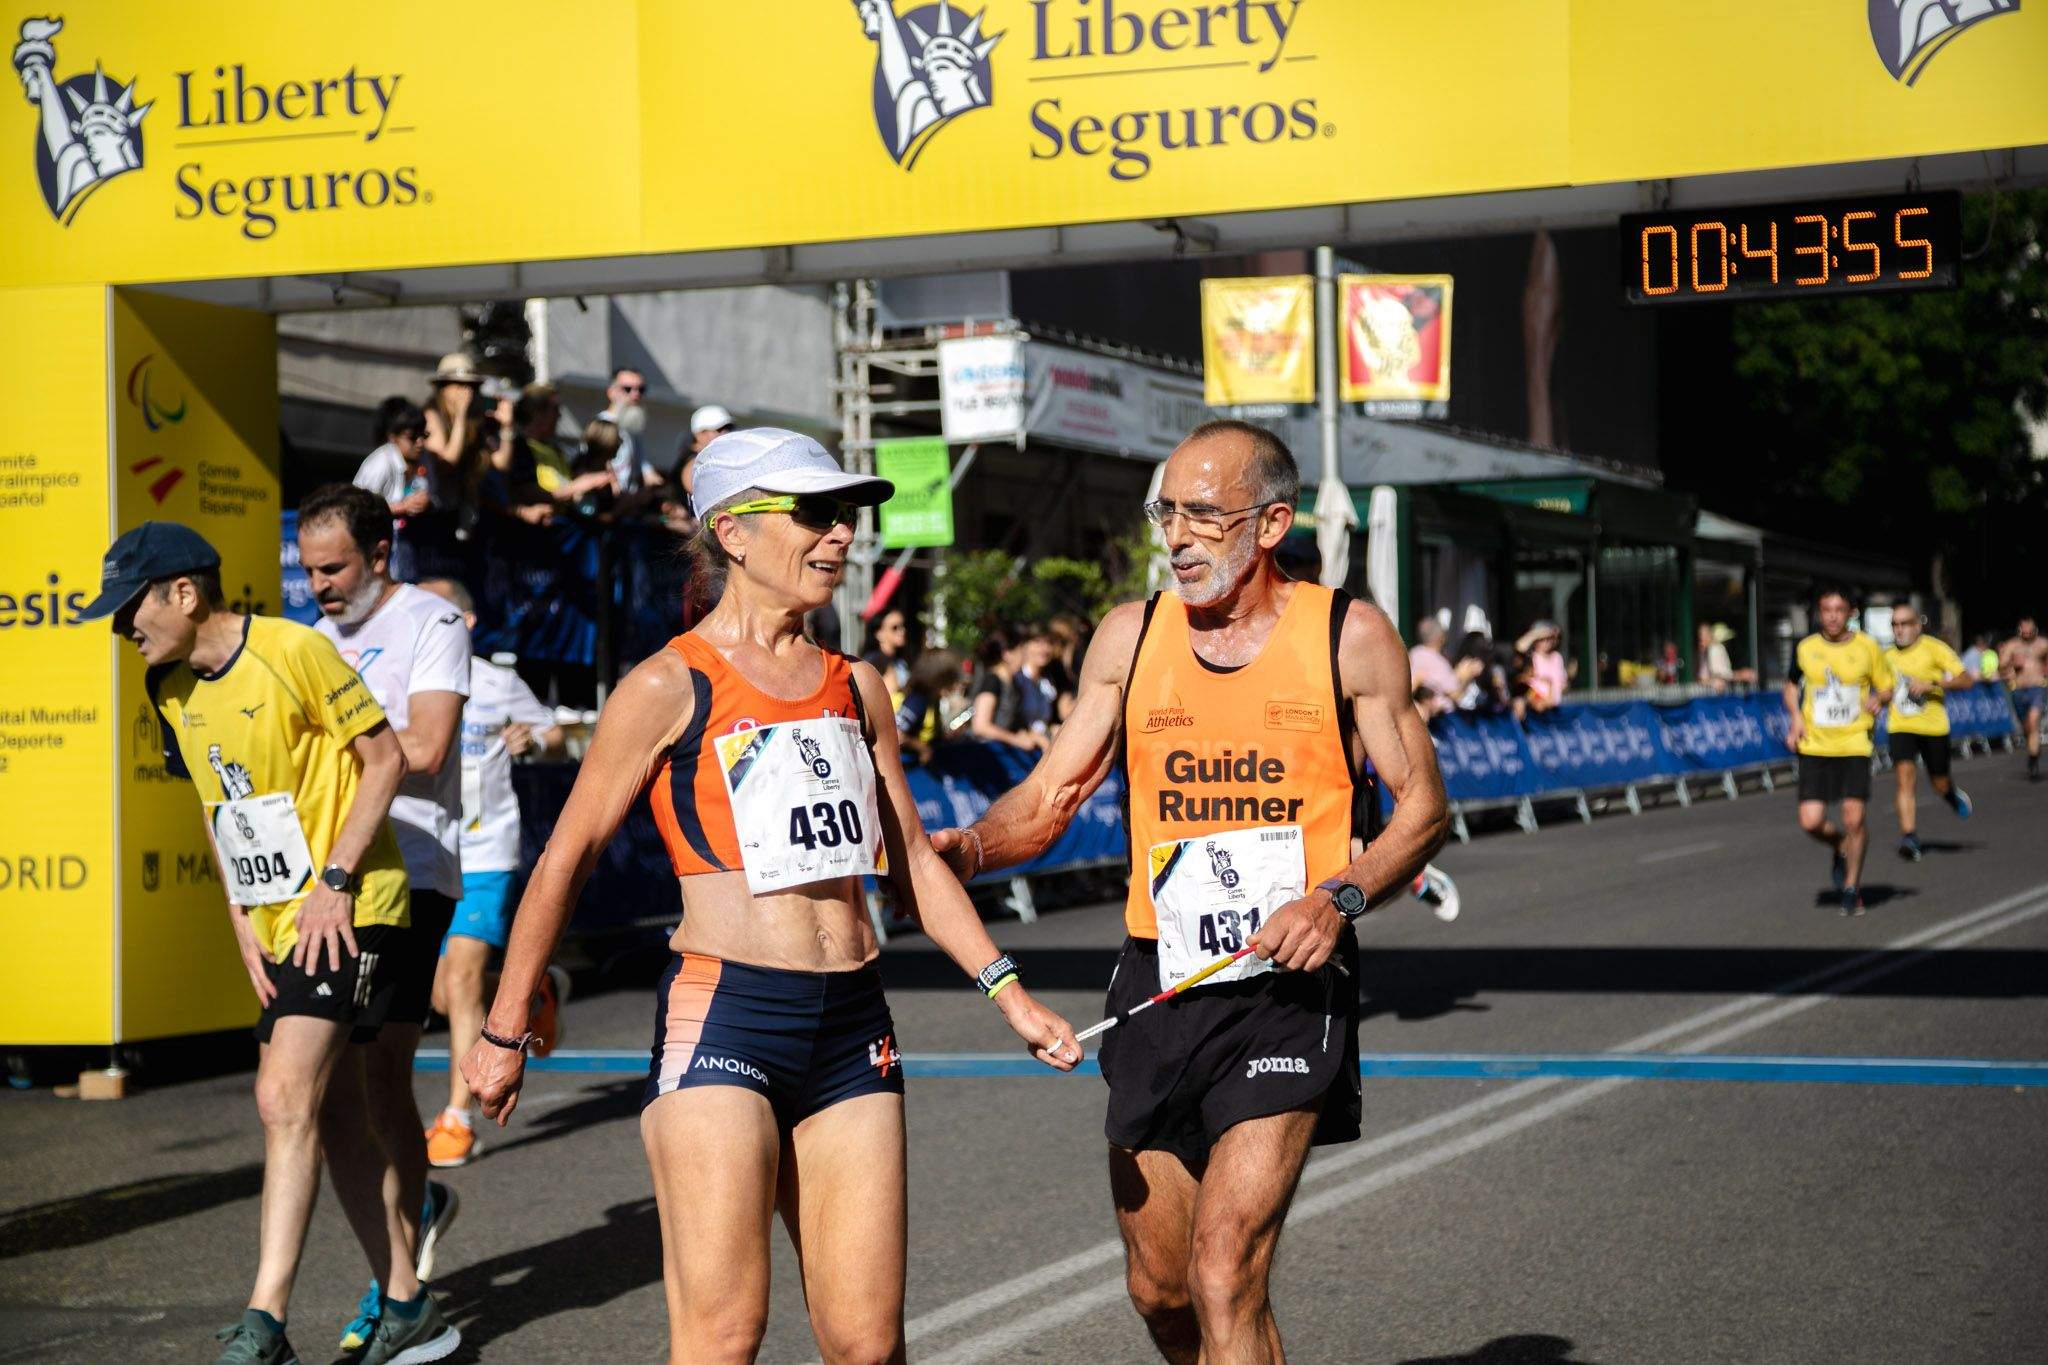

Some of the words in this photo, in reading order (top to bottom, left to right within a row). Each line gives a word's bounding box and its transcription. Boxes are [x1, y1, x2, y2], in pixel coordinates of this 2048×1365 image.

[1031, 0, 1299, 73] Liberty
[174, 64, 404, 141] Liberty
[30, 705, 97, 724] Mundial
[1146, 715, 1194, 728] Athletics
[815, 762, 827, 774] 13
[1165, 750, 1285, 784] Guide
[1159, 789, 1303, 822] Runner
[789, 799, 863, 851] 430
[1223, 873, 1236, 884] 13
[1199, 907, 1262, 957] 431
